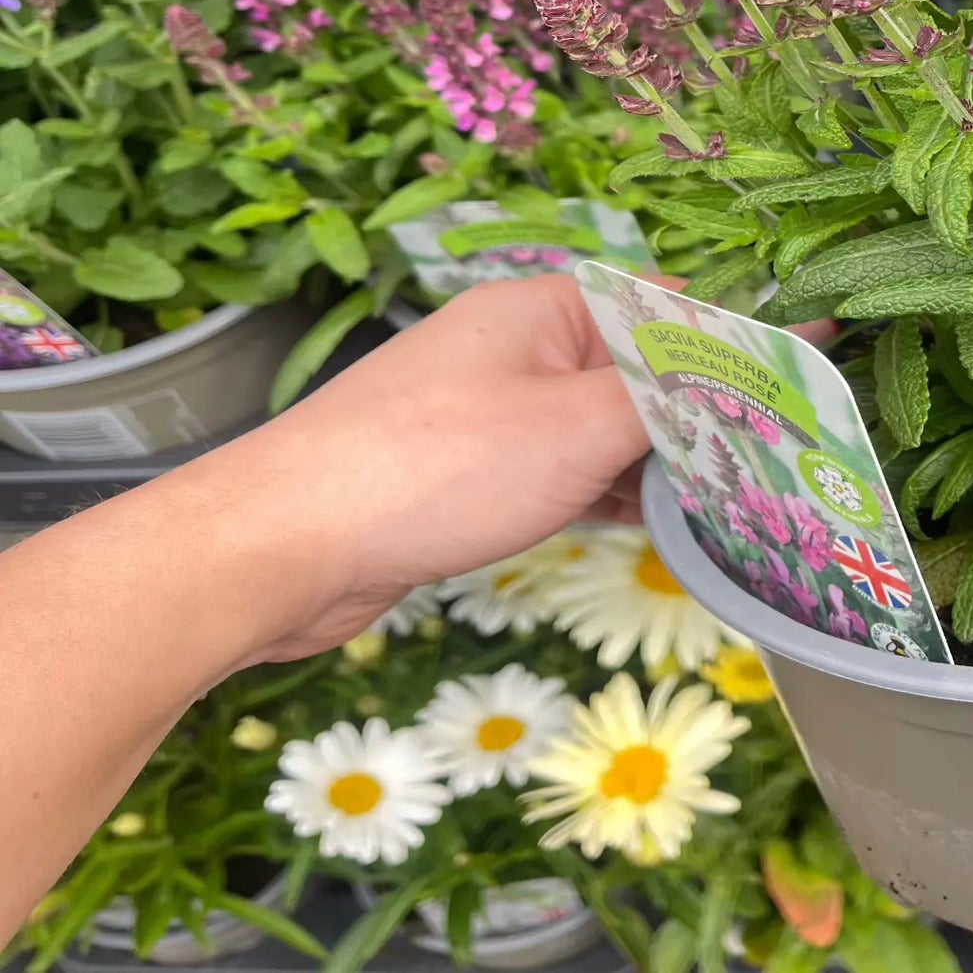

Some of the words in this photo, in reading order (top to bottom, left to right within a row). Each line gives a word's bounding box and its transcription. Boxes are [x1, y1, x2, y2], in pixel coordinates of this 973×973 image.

[649, 329, 698, 349] SALVIA
[699, 339, 782, 396] SUPERBA
[665, 349, 729, 377] MERLEAU
[733, 370, 778, 405] ROSE
[677, 373, 783, 426] ALPINE/PERENNIAL
